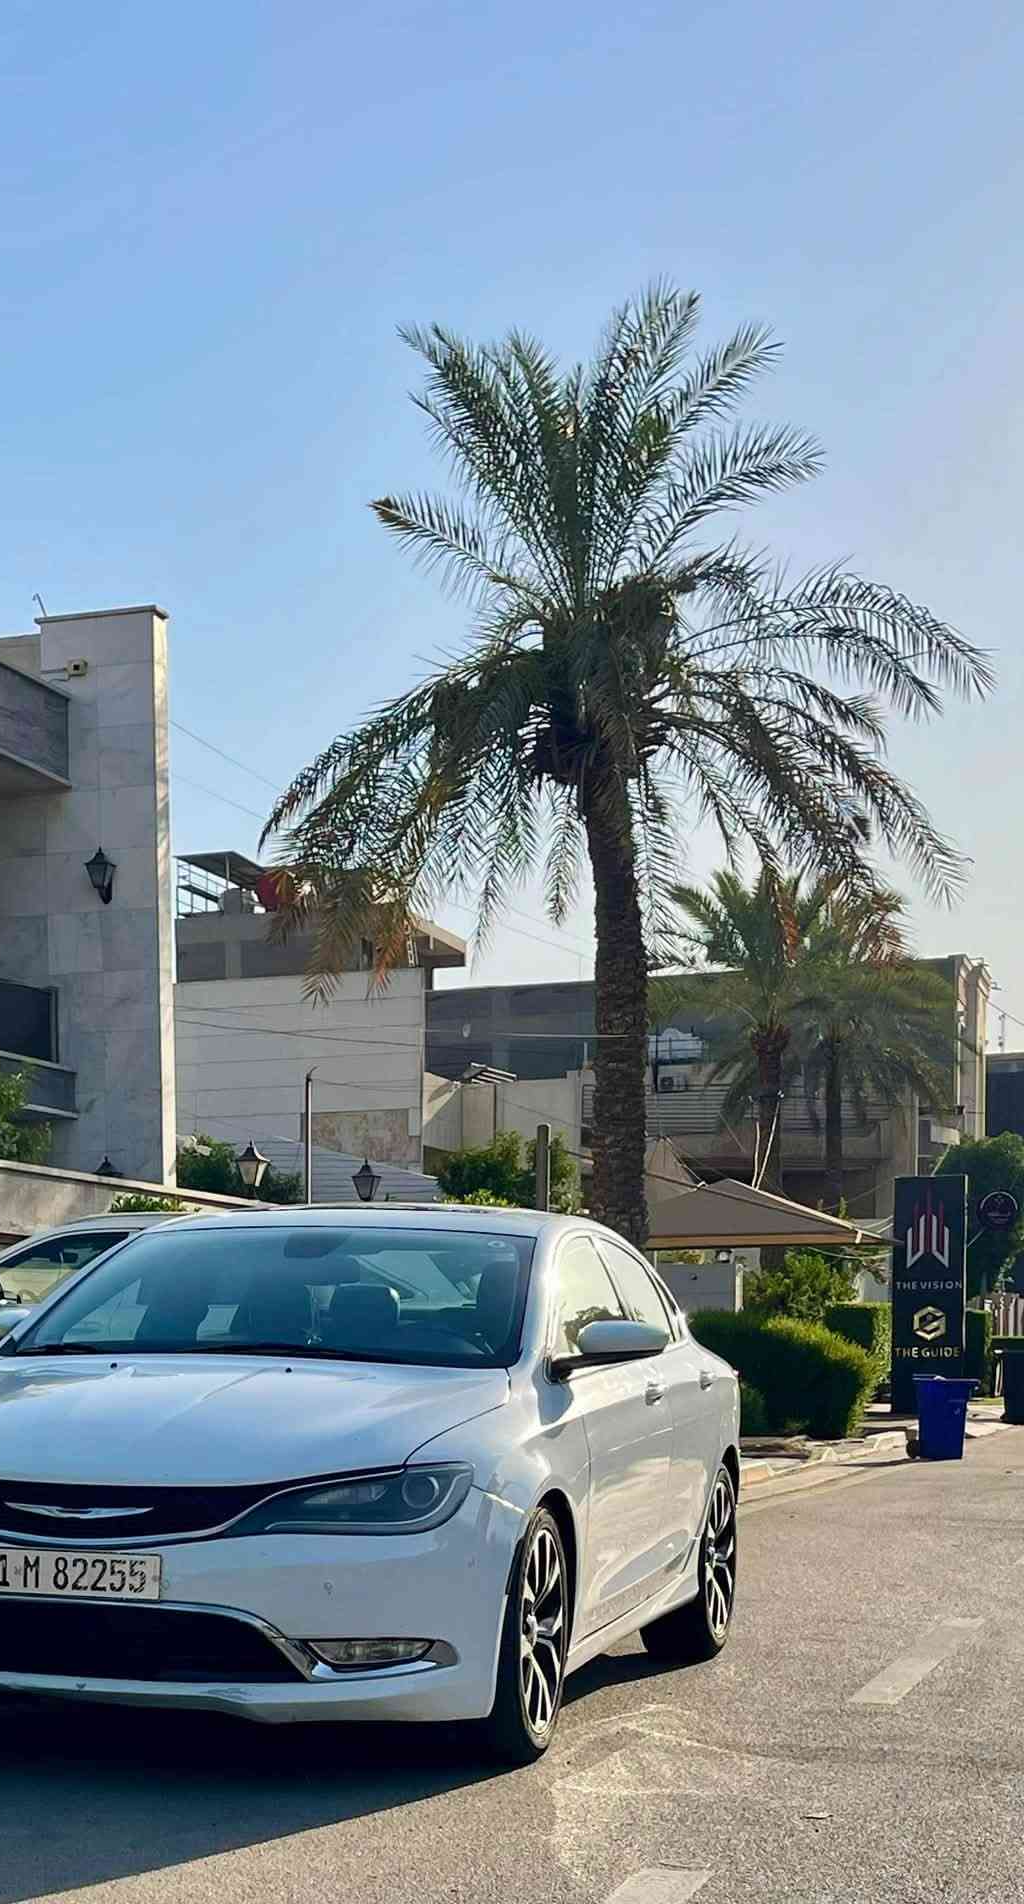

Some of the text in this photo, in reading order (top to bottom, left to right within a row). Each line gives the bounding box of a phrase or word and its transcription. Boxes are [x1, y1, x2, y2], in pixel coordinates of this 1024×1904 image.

[896, 1281, 963, 1290] THE VISION
[895, 1347, 961, 1358] THE GUIDE
[23, 1555, 40, 1588] M
[53, 1556, 146, 1593] 82255
